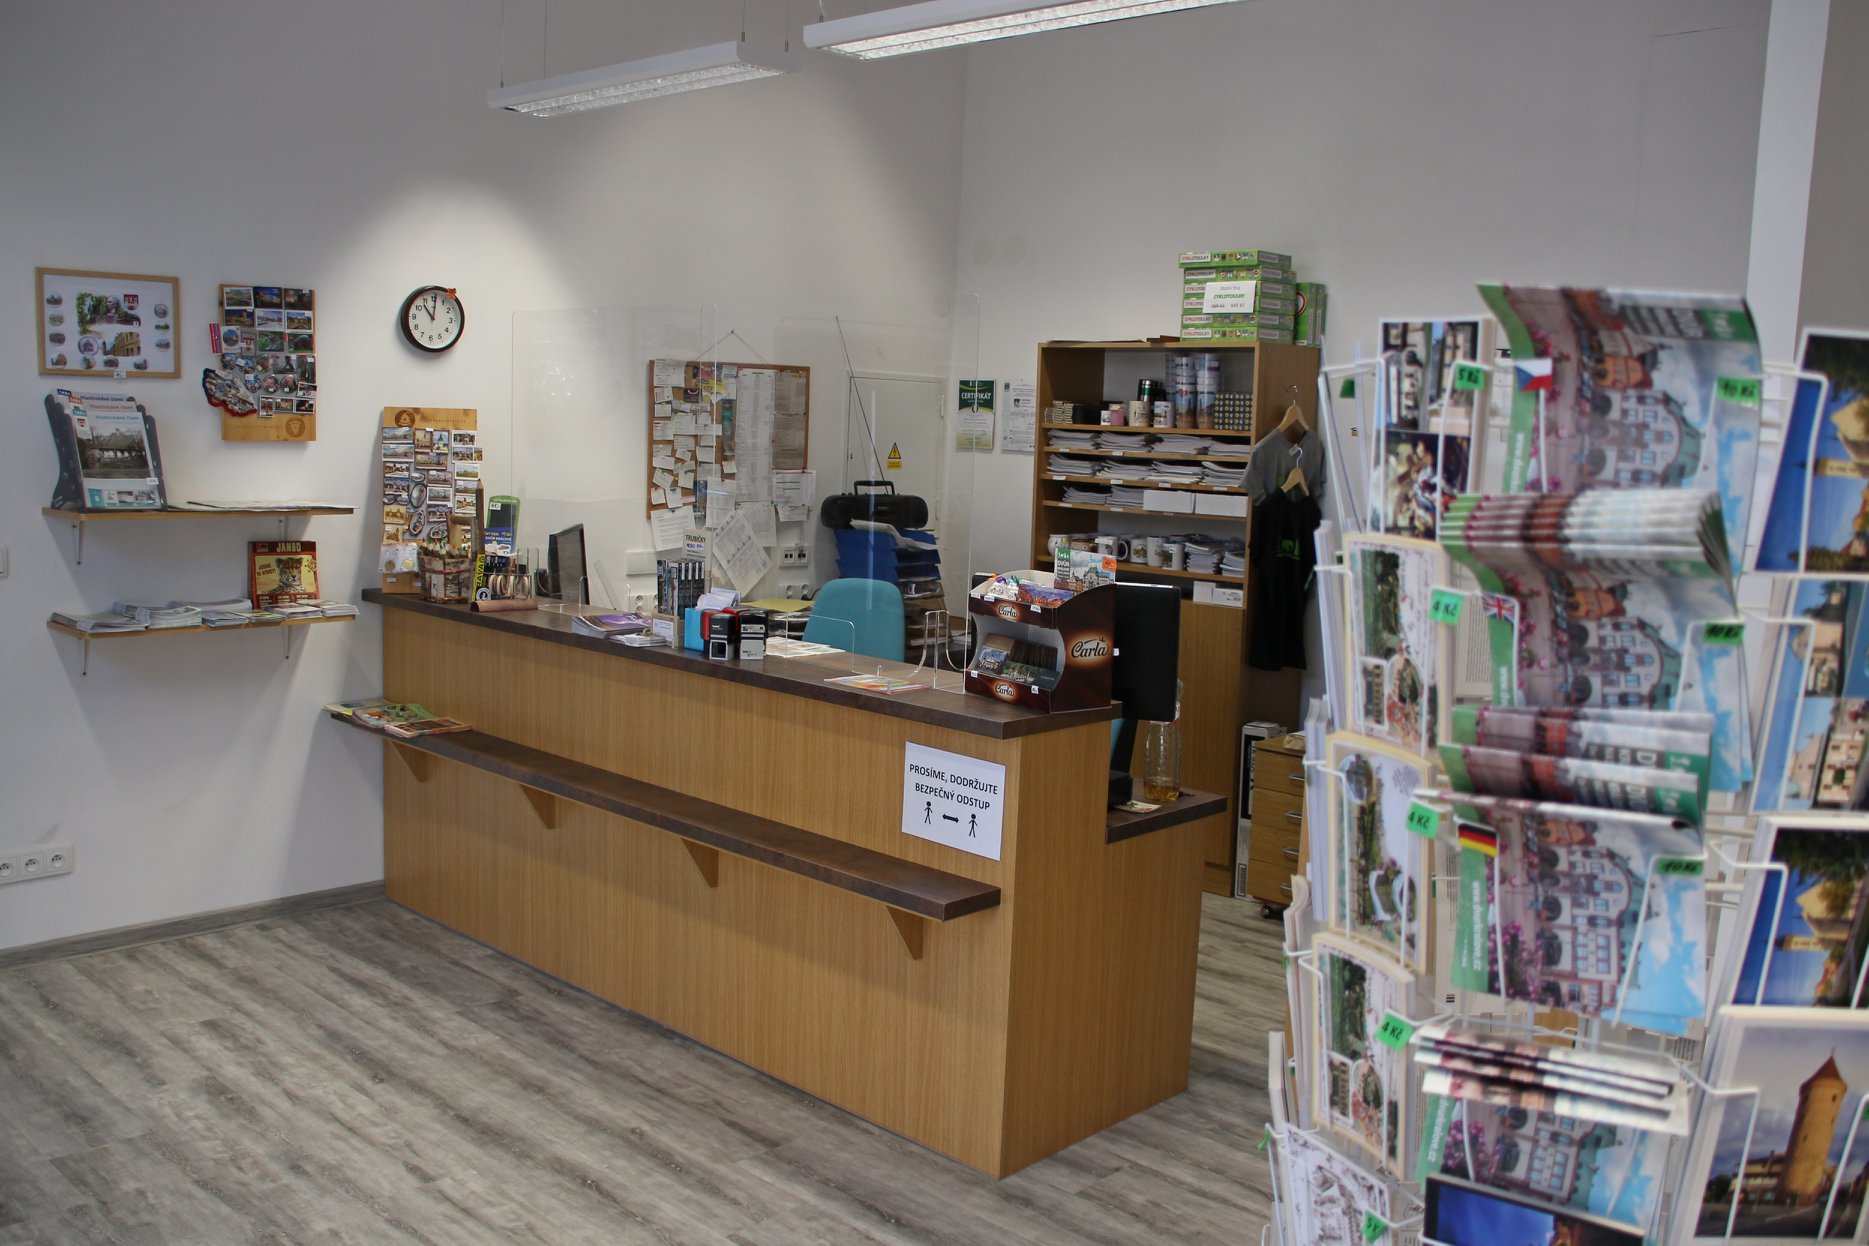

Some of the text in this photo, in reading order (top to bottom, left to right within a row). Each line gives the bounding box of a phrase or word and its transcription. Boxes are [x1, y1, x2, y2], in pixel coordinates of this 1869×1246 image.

[1458, 367, 1466, 381] 5
[961, 391, 991, 400] CERTIFIKÁT
[1721, 382, 1738, 397] 10
[685, 534, 706, 543] TRUBIČKY
[276, 542, 302, 552] JAMBO
[998, 605, 1017, 618] Carla
[1432, 601, 1440, 612] 4
[1071, 640, 1110, 659] Carla
[994, 683, 1014, 697] Carla
[909, 763, 998, 795] PROSÍME, DODRŽUJTE
[915, 782, 990, 810] BEZPEČNÝ ODSTUP
[1408, 811, 1415, 823] 4
[1662, 862, 1682, 873] 10
[1381, 1021, 1403, 1041] 4 Kč
[1366, 1217, 1373, 1228] 5
